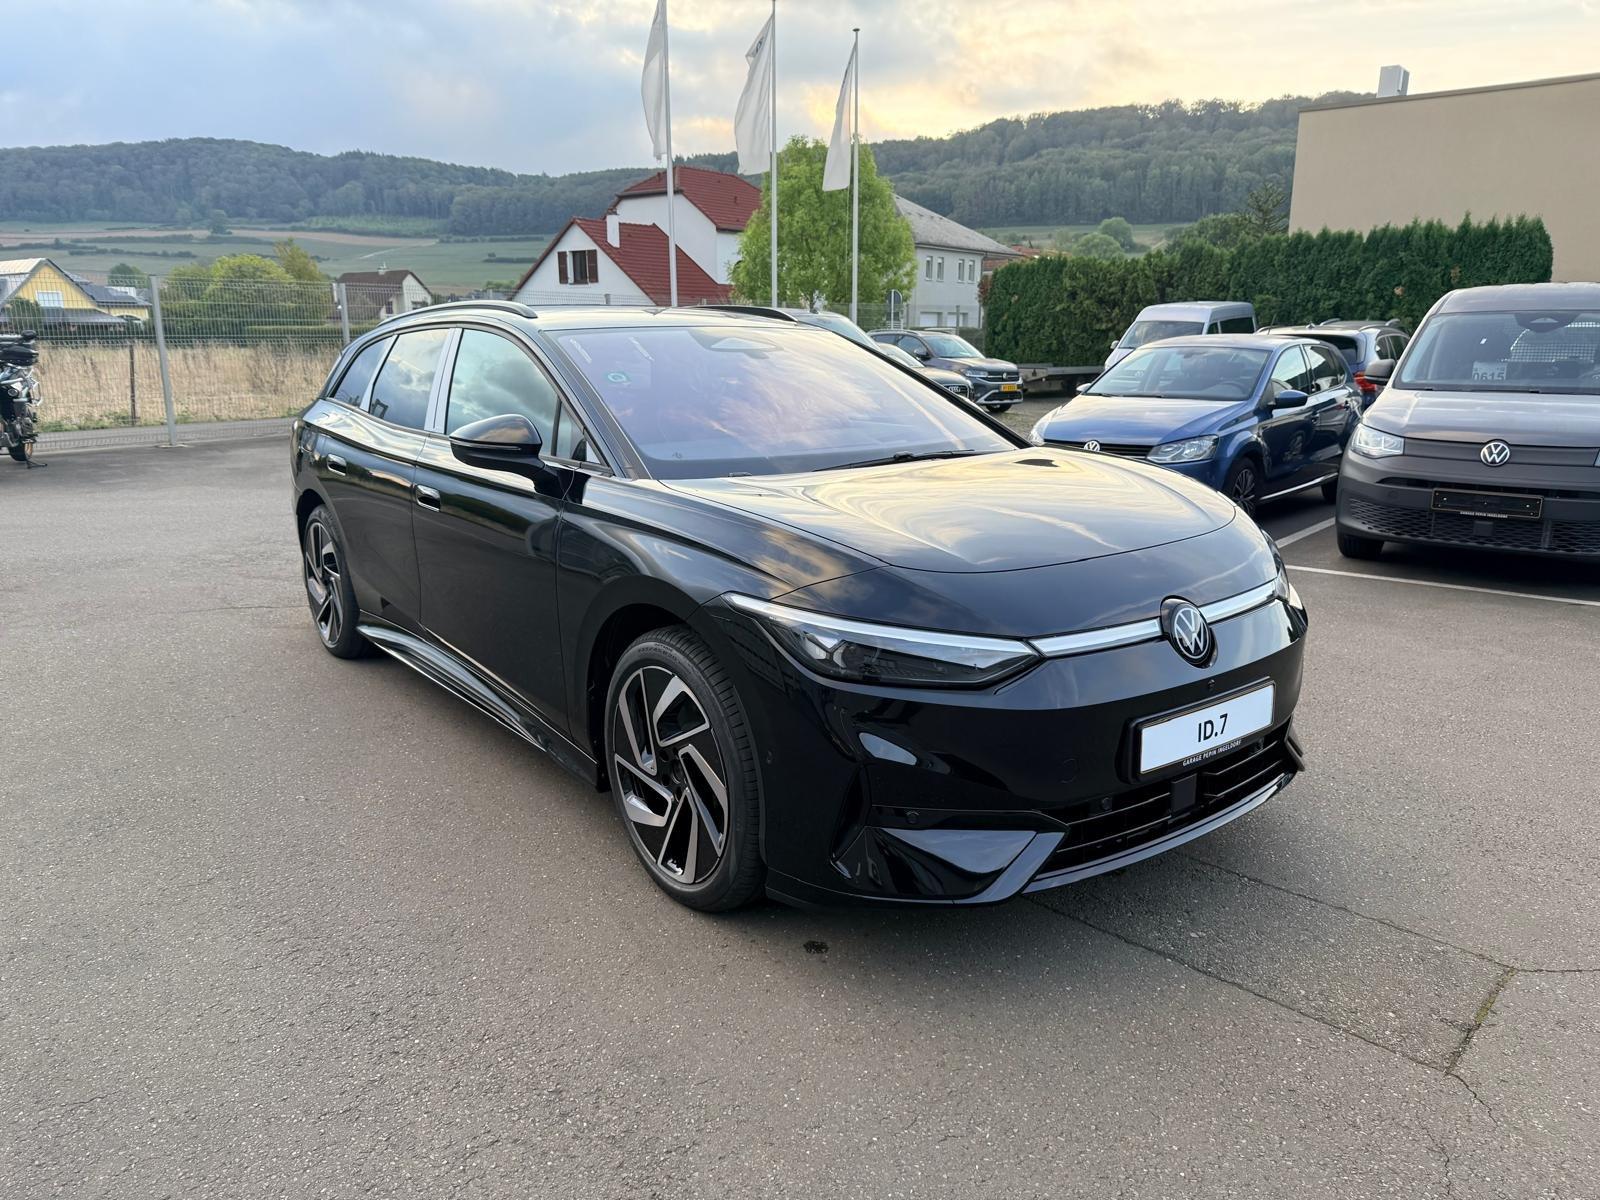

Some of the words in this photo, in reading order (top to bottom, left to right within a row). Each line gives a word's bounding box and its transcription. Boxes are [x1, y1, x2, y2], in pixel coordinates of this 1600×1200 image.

[1481, 442, 1510, 466] VW
[1174, 607, 1208, 658] VW
[1198, 713, 1228, 743] ID.7
[1182, 754, 1202, 767] GARAGE
[1203, 749, 1217, 759] PEPIN
